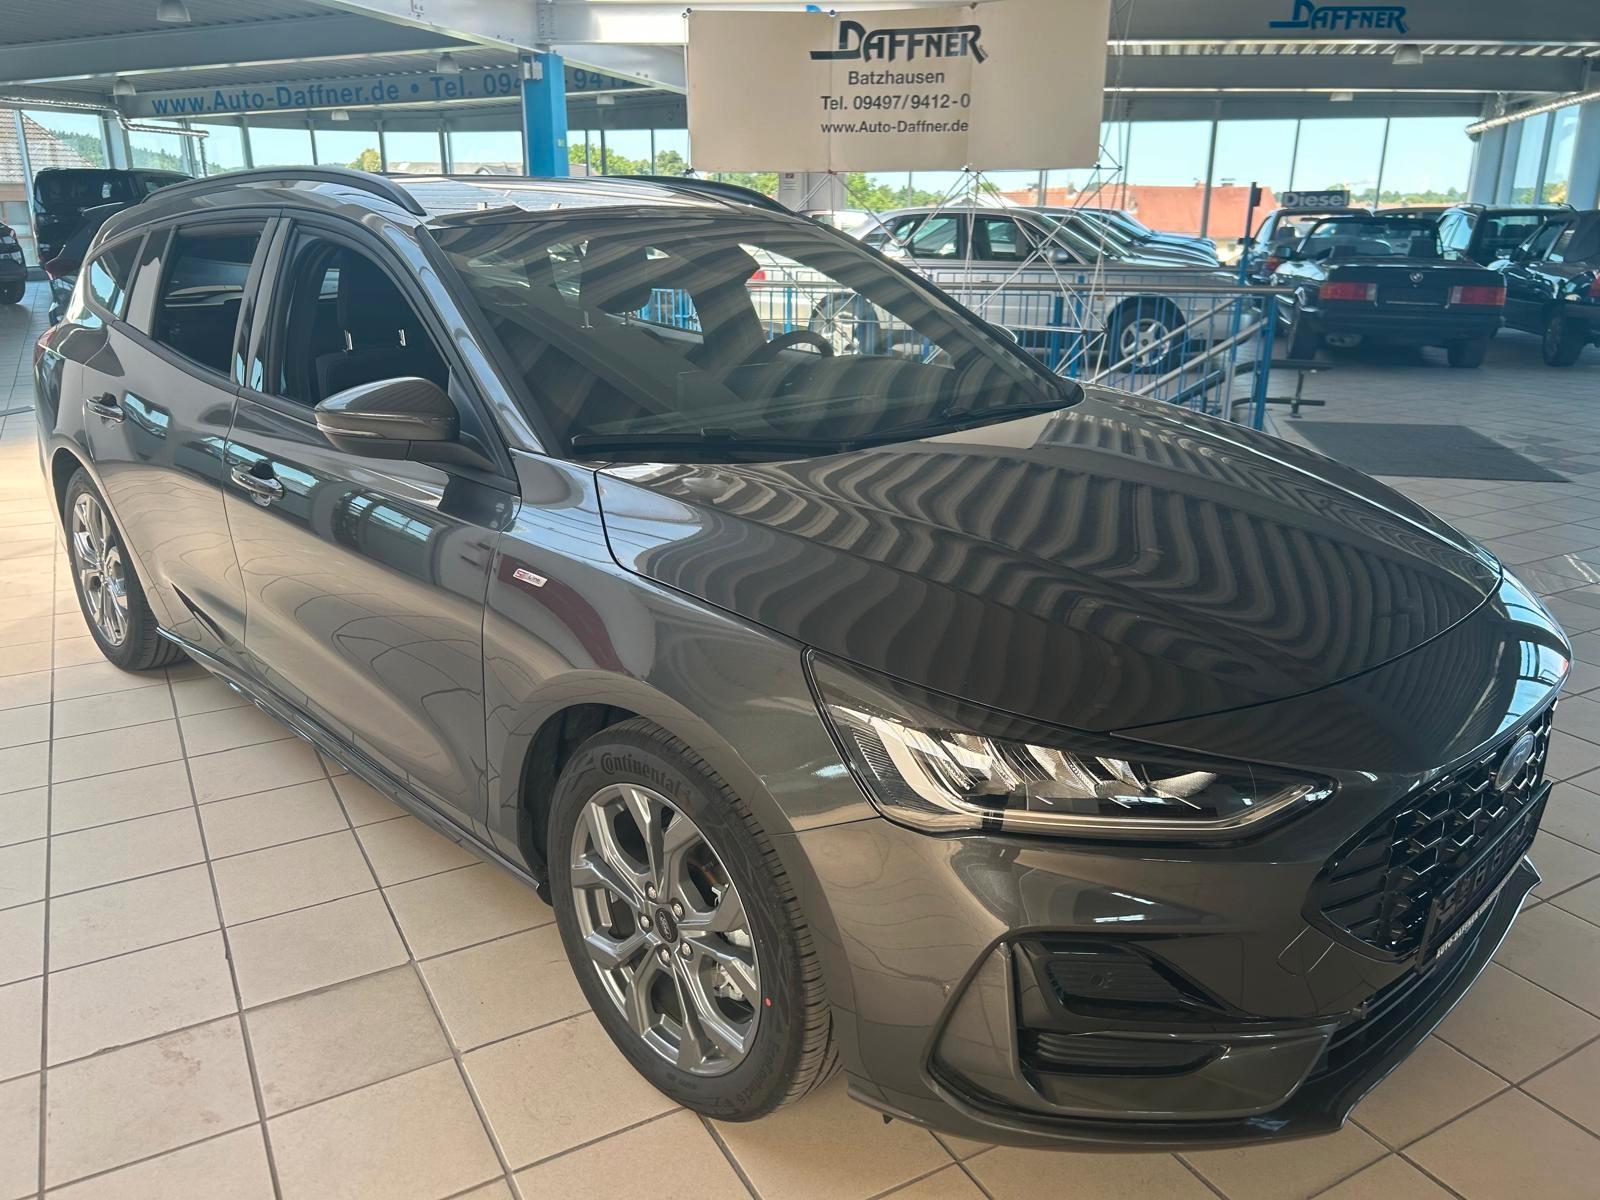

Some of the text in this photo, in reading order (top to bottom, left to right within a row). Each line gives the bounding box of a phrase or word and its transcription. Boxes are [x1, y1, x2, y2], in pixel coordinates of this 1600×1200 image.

[1269, 0, 1409, 33] DAFFNER
[810, 20, 986, 63] DAFFNER
[848, 70, 945, 85] Batzhausen
[152, 79, 400, 114] www.Auto-Daffner.de
[430, 75, 473, 98] Tel.
[821, 93, 971, 110] Tel. 09497/9412-0
[820, 119, 969, 134] www.Auto-Daffner.de
[1284, 191, 1348, 207] Diesel
[600, 752, 682, 799] Continental
